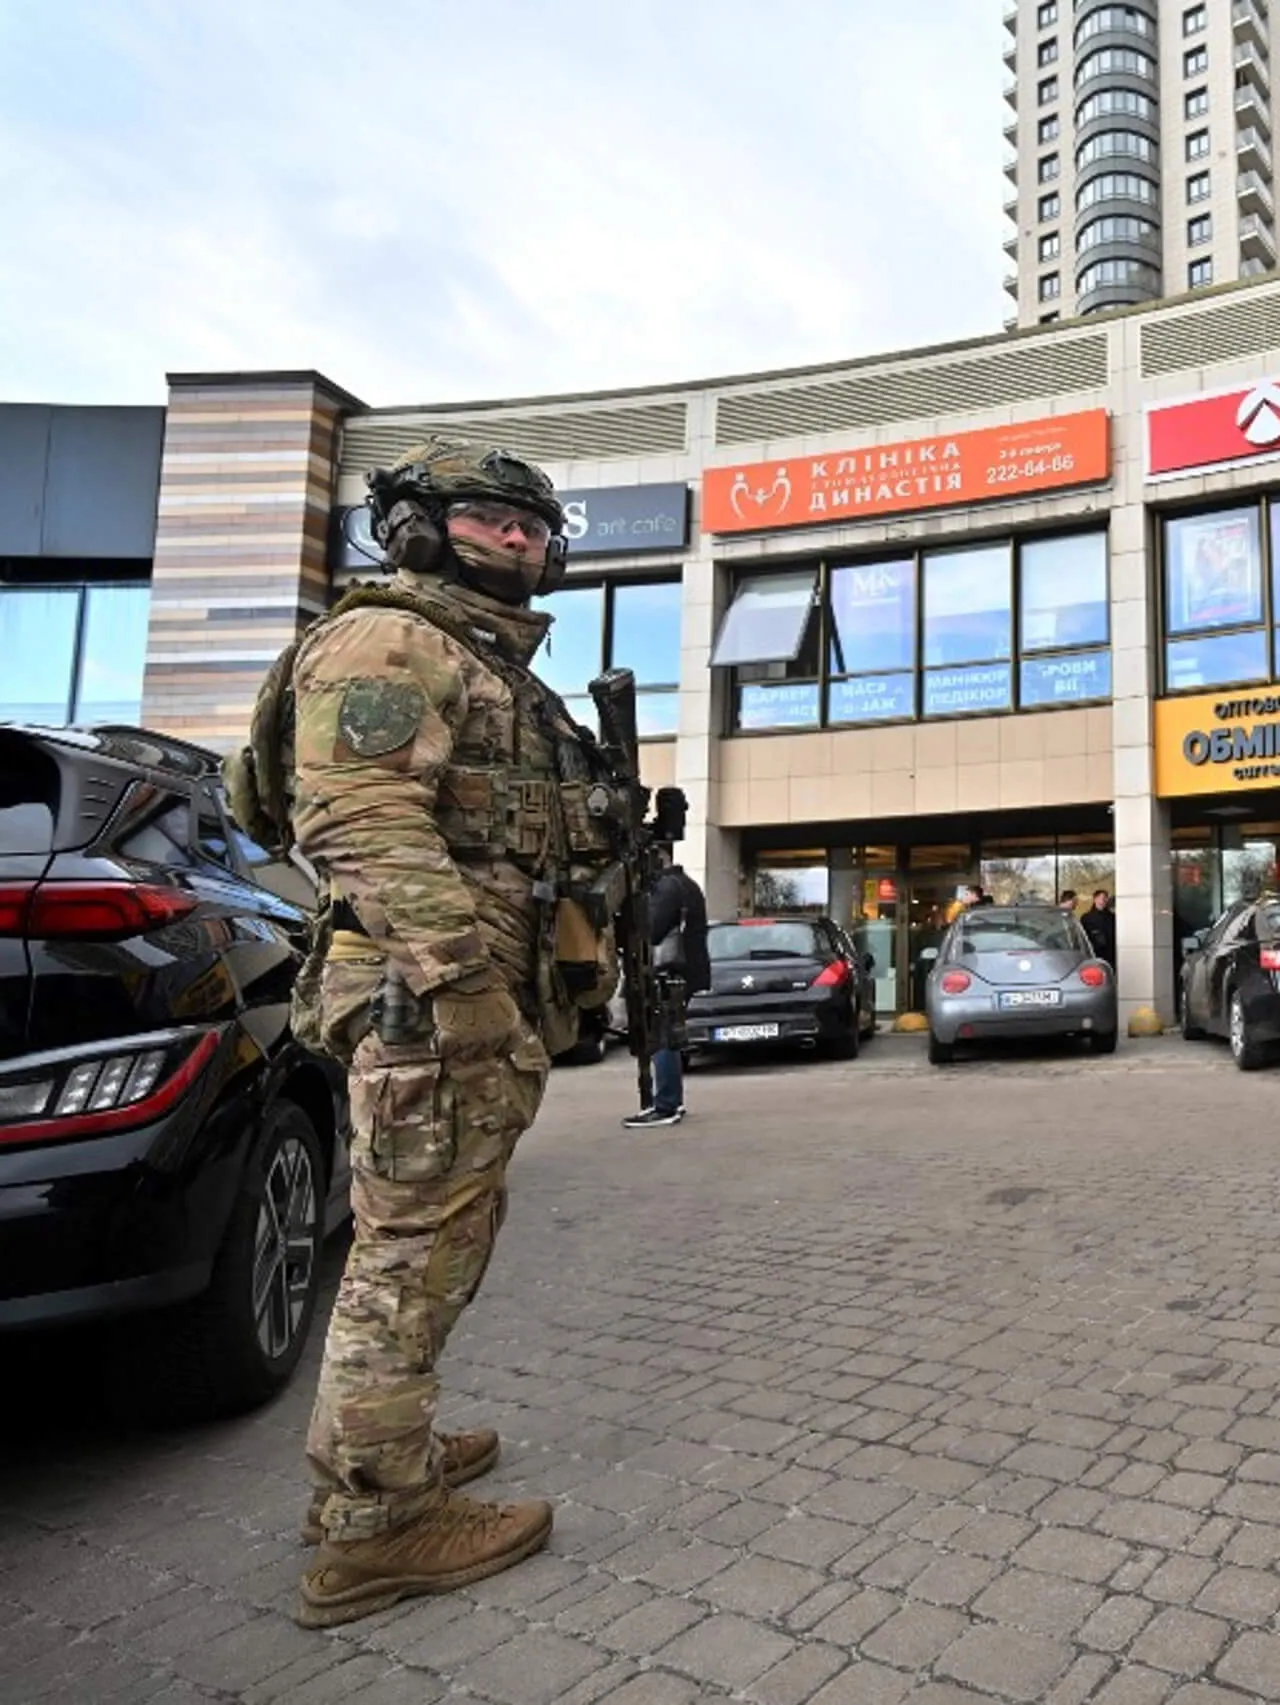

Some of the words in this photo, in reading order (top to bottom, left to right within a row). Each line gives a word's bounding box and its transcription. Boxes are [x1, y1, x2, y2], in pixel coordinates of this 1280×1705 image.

[811, 442, 960, 478] КЛІНІКА
[809, 472, 962, 512] ДИНАСТІЯ
[597, 516, 627, 536] art
